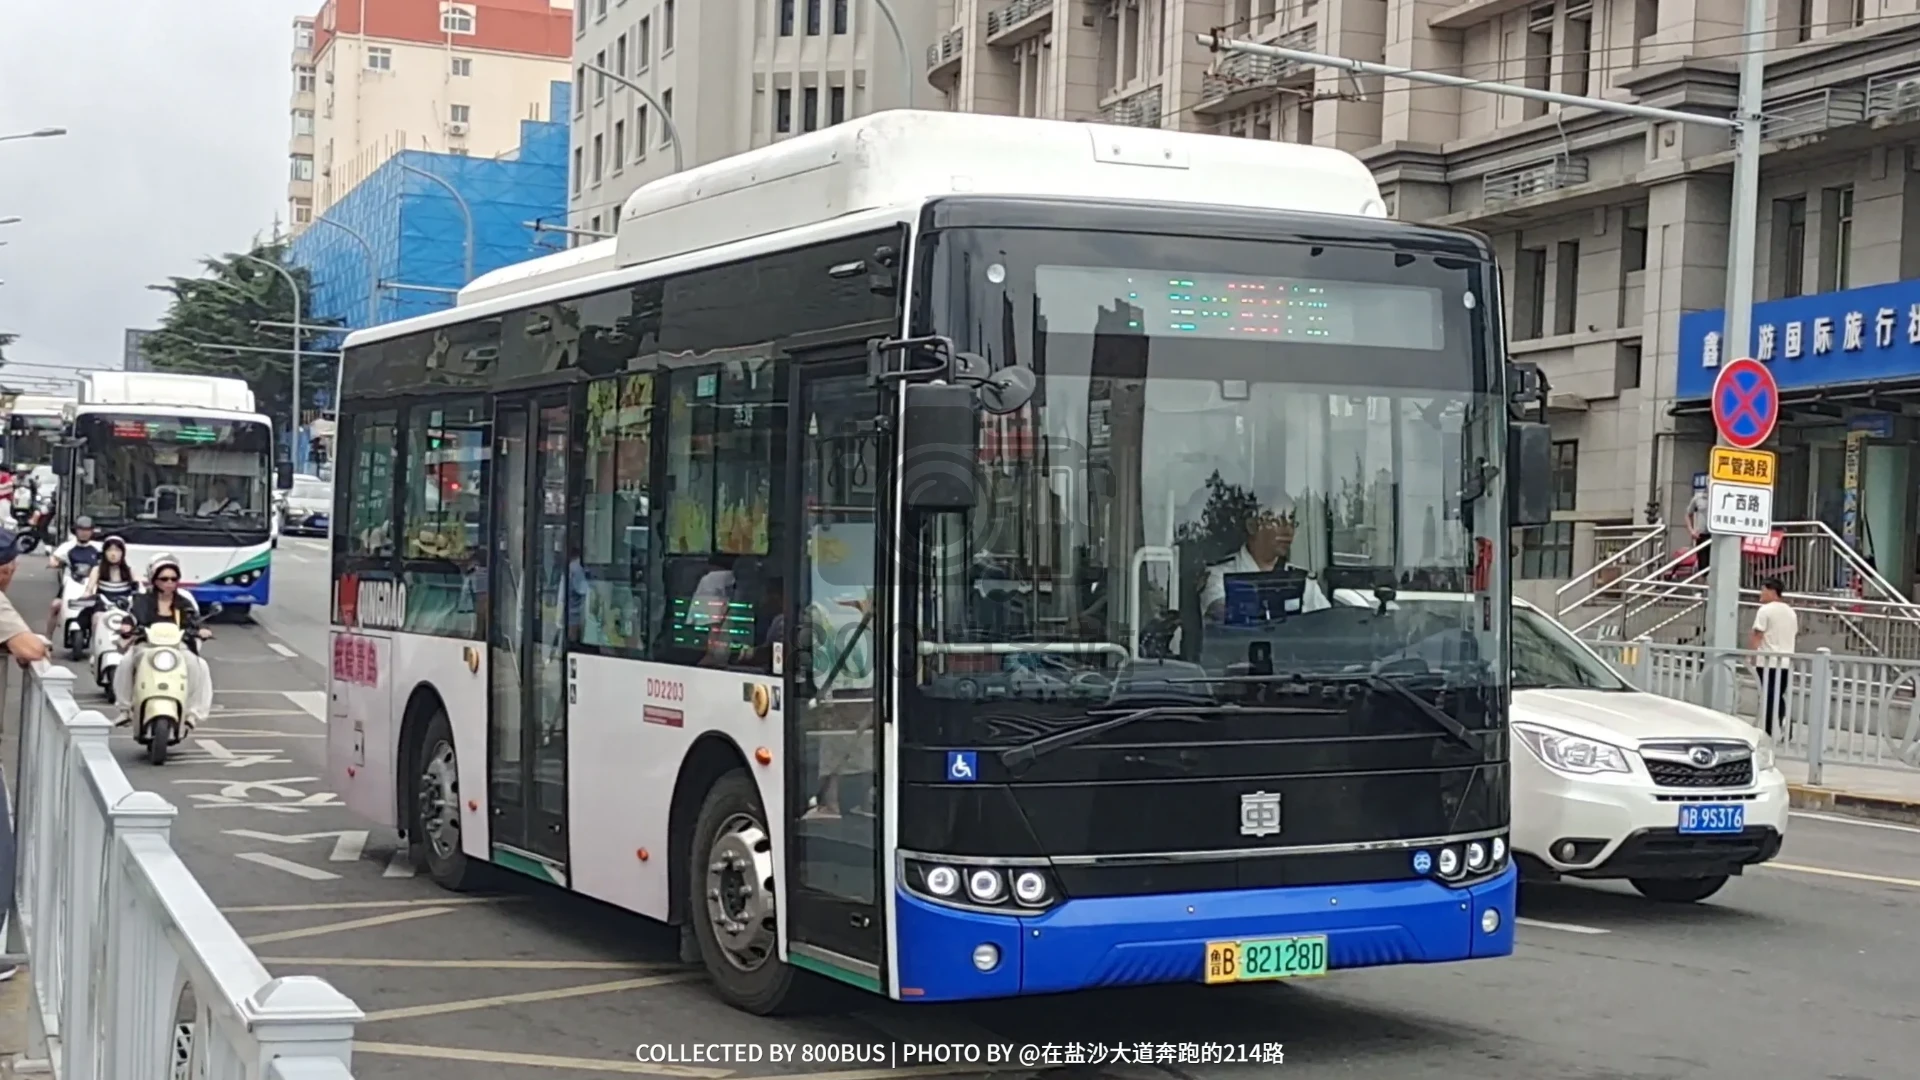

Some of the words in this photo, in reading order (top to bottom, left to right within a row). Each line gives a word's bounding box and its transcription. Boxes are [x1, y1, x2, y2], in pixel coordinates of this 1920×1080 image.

[1717, 456, 1768, 478] 严管路段
[1721, 492, 1760, 512] 广西路
[357, 578, 407, 632] QINGDAO
[647, 677, 684, 702] DD2203
